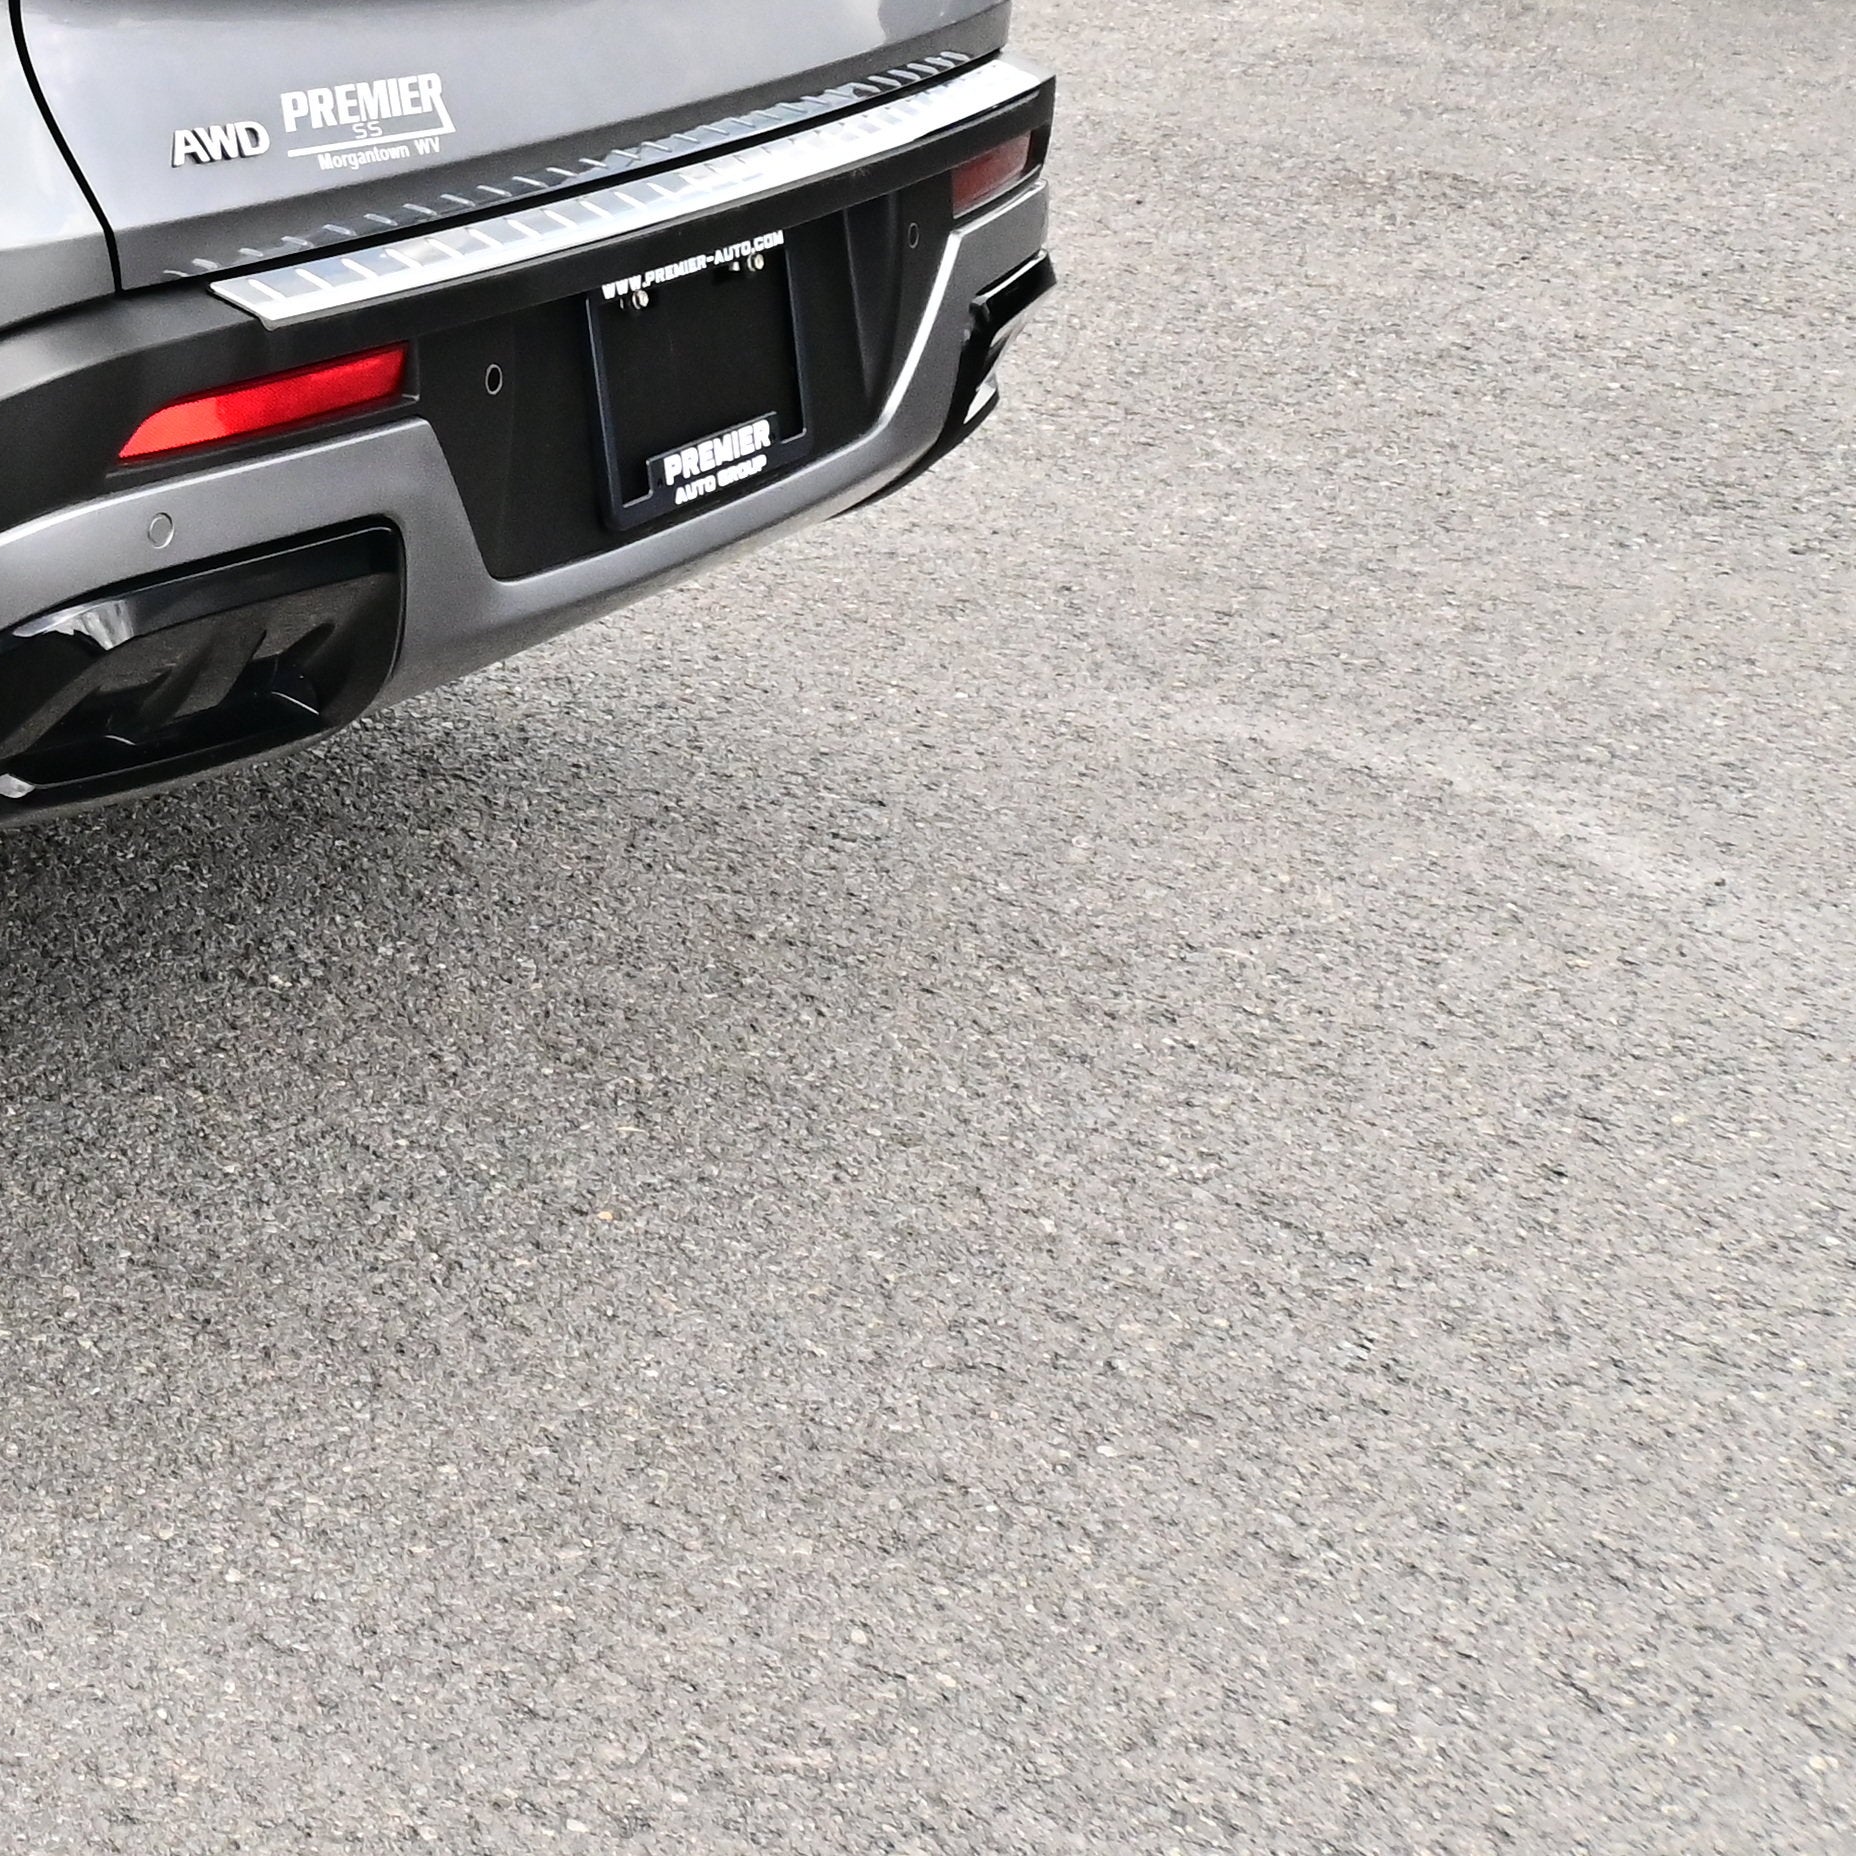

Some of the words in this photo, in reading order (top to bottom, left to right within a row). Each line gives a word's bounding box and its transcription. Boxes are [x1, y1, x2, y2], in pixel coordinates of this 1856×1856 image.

[279, 72, 450, 134] PREMIER
[171, 120, 271, 168] AWD
[317, 143, 411, 171] Morgantown
[413, 136, 441, 157] WV
[601, 229, 785, 300] WWW.PREMIER-AUTO.COM
[663, 419, 772, 486] PREMIER
[674, 474, 717, 505] AUTO
[716, 454, 768, 487] GROUP
